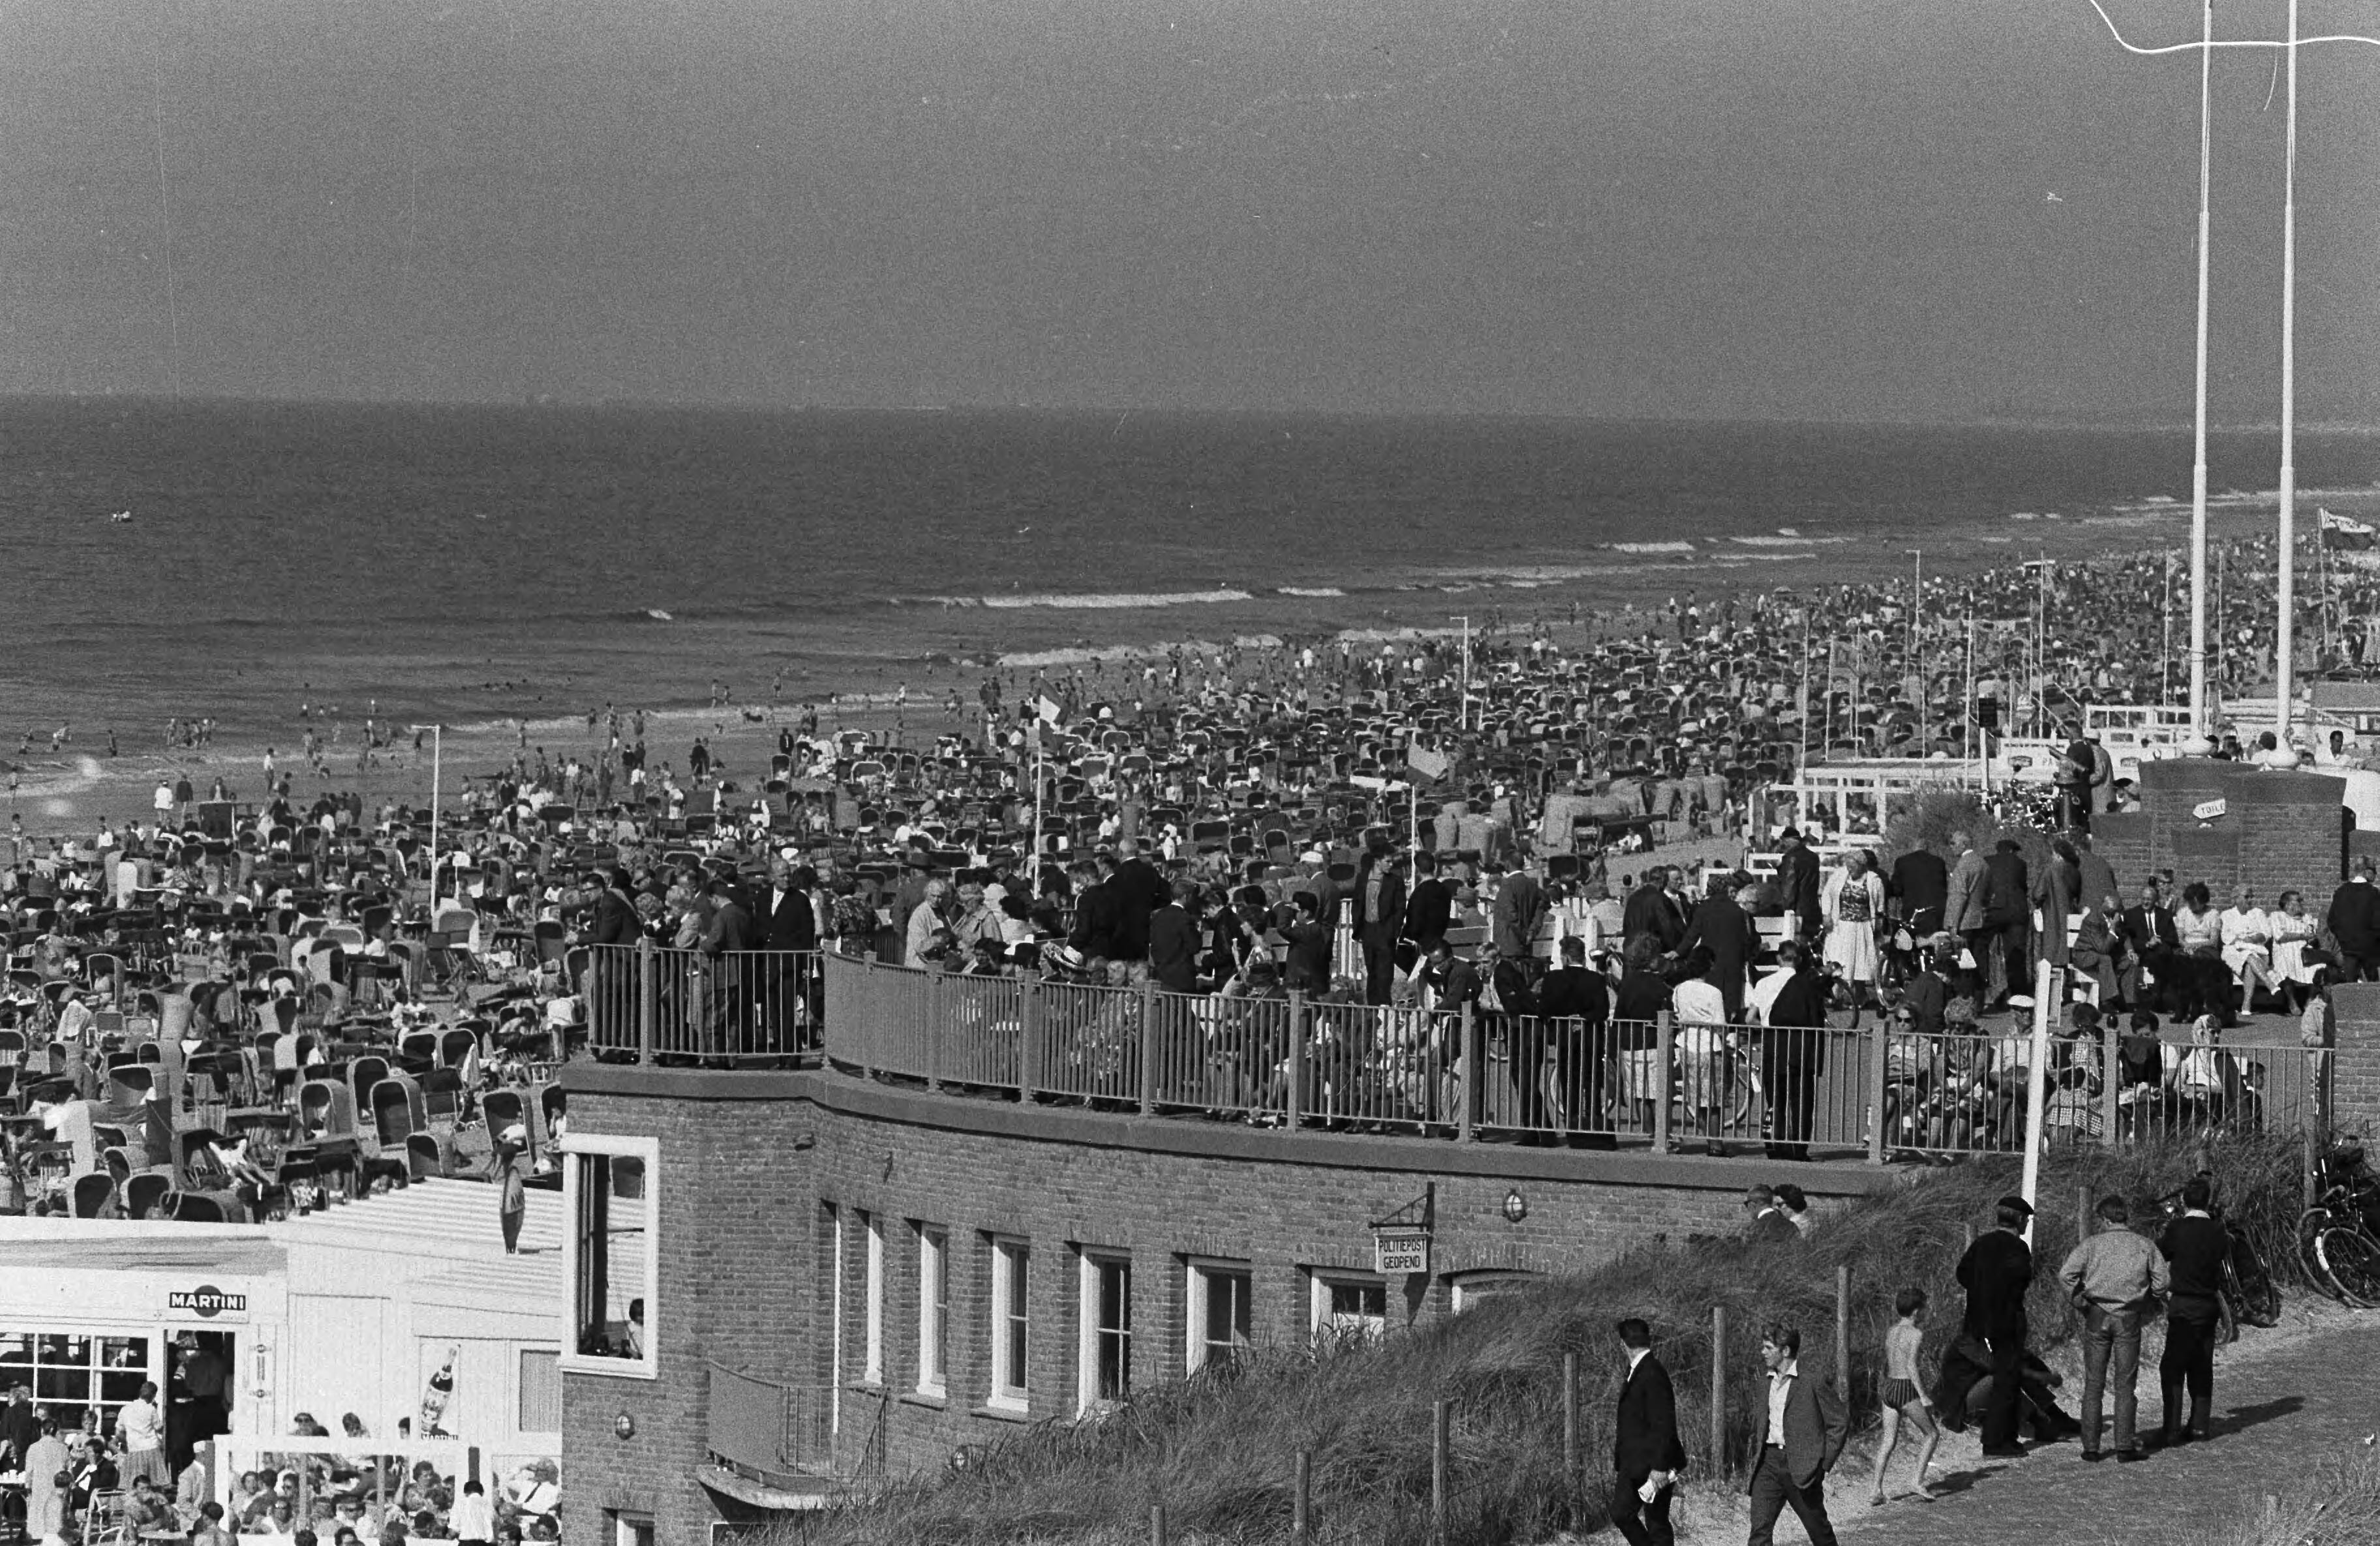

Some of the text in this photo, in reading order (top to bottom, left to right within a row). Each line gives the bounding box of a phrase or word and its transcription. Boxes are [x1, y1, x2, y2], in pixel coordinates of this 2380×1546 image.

[1379, 1239, 1425, 1252] POLITIEPOST
[1384, 1256, 1420, 1268] GEOPEND
[172, 1294, 244, 1309] MARTINI
